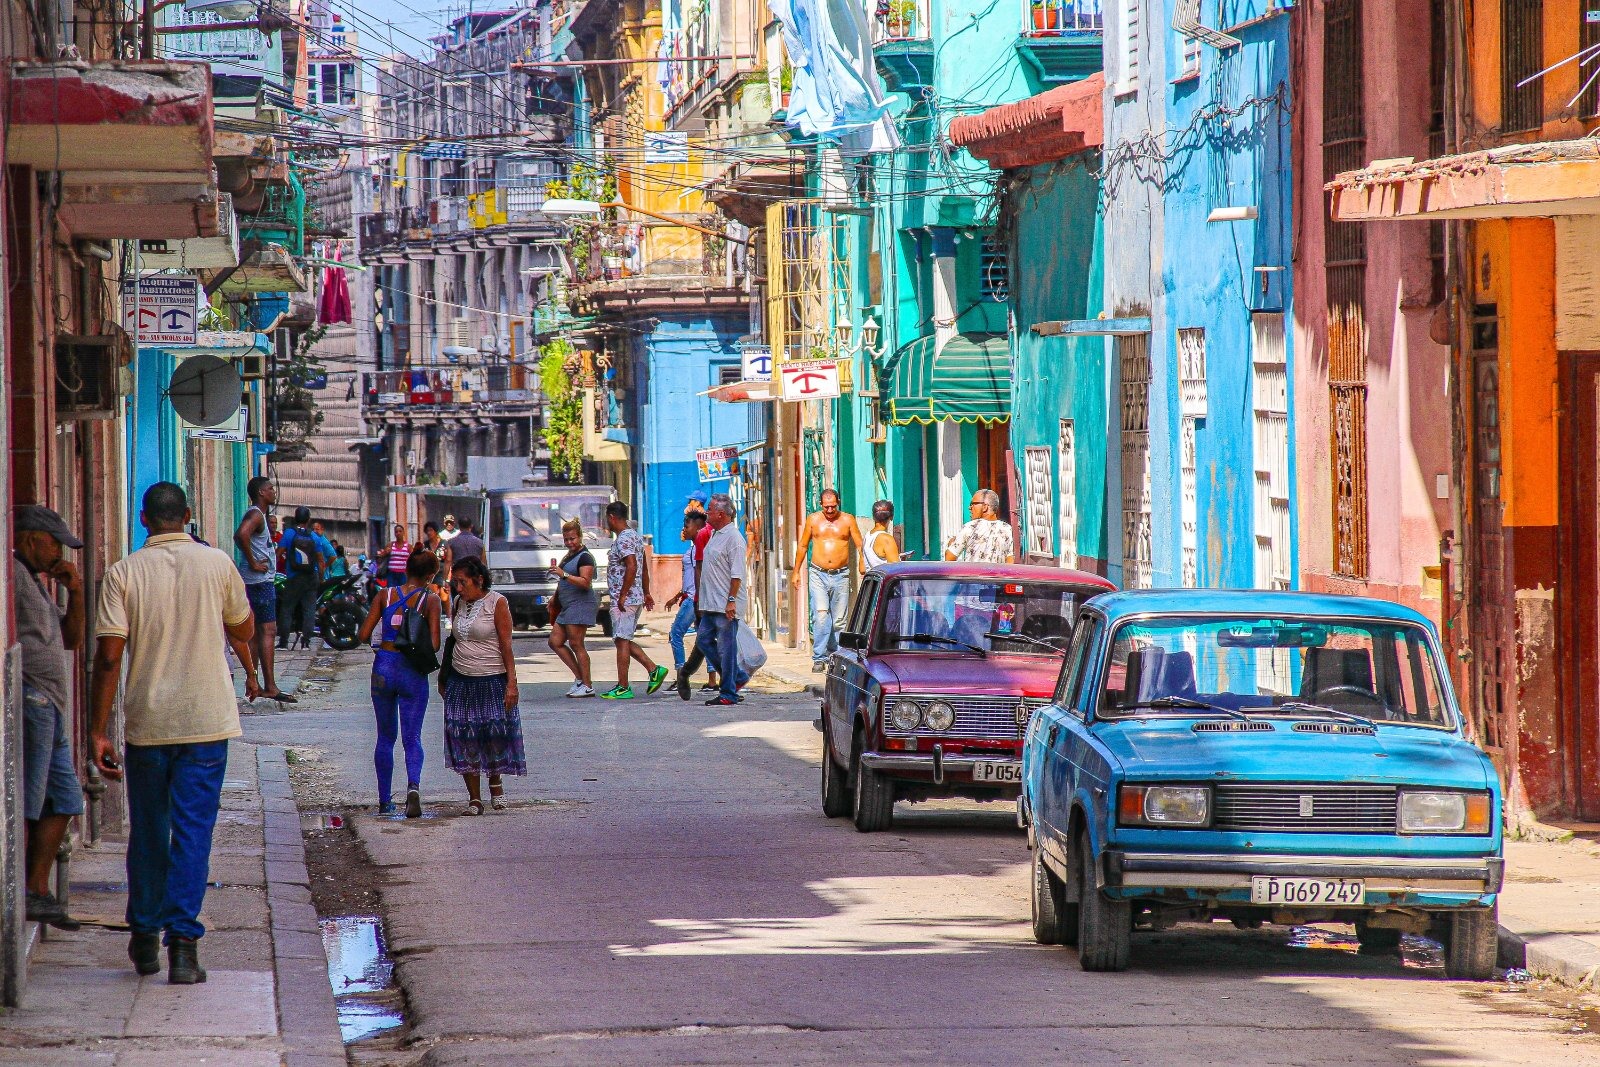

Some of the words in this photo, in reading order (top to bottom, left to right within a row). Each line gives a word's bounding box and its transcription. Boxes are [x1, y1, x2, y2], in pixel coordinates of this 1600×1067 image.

[985, 764, 993, 779] P
[995, 765, 1022, 781] 054
[1268, 881, 1279, 901] P
[1284, 881, 1320, 902] 069
[1324, 881, 1361, 902] 249
